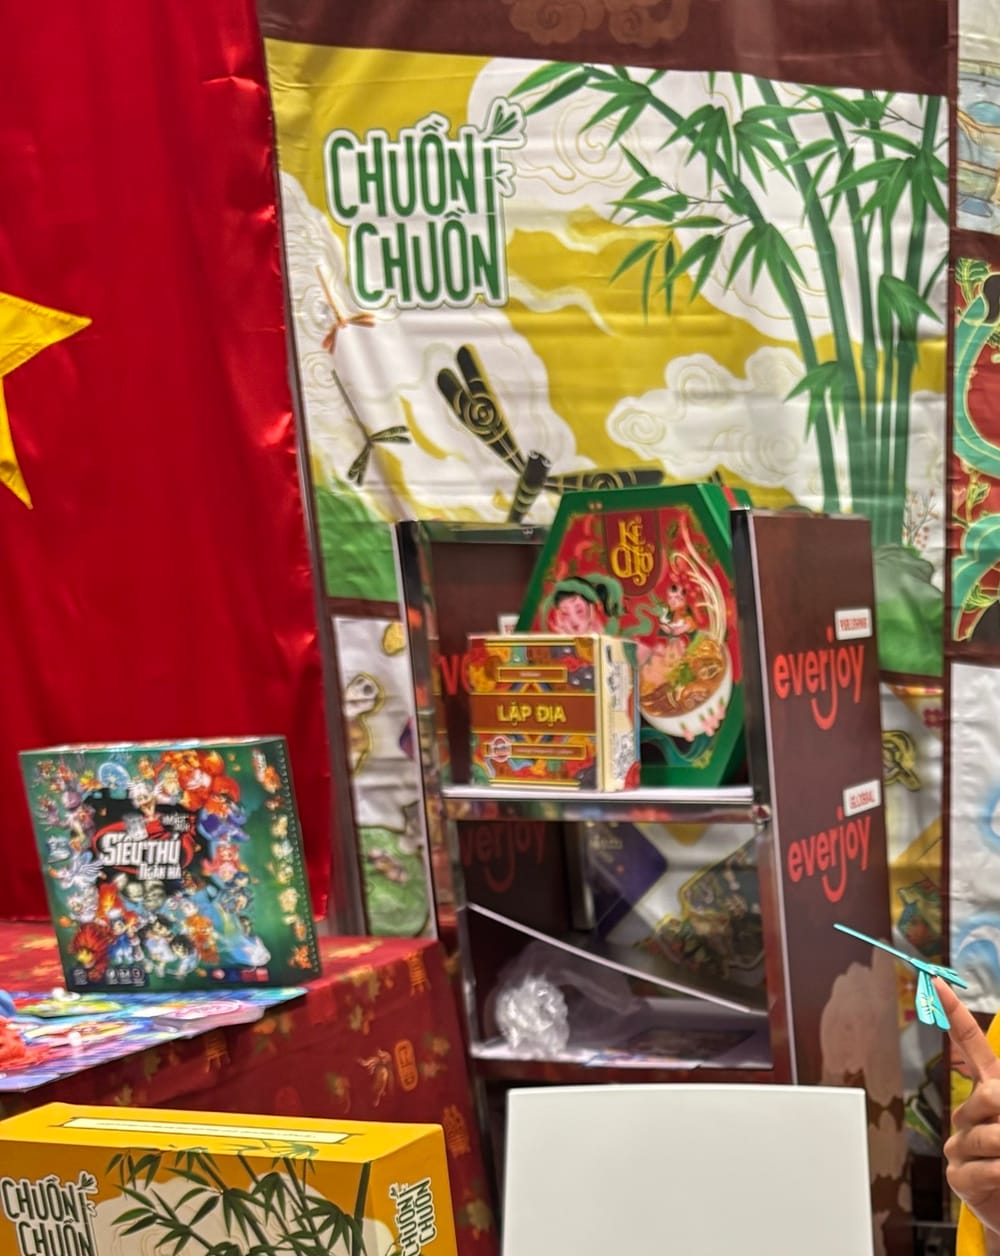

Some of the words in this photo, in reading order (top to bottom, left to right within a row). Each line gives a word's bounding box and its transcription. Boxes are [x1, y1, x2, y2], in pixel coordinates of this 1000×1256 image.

[330, 120, 478, 219] CHUỒN
[355, 208, 502, 302] CHUỒN
[773, 626, 865, 731] everjoy
[787, 805, 871, 903] everjoy
[2, 1177, 80, 1222] CHUỒN
[412, 1180, 436, 1243] CHUỒN
